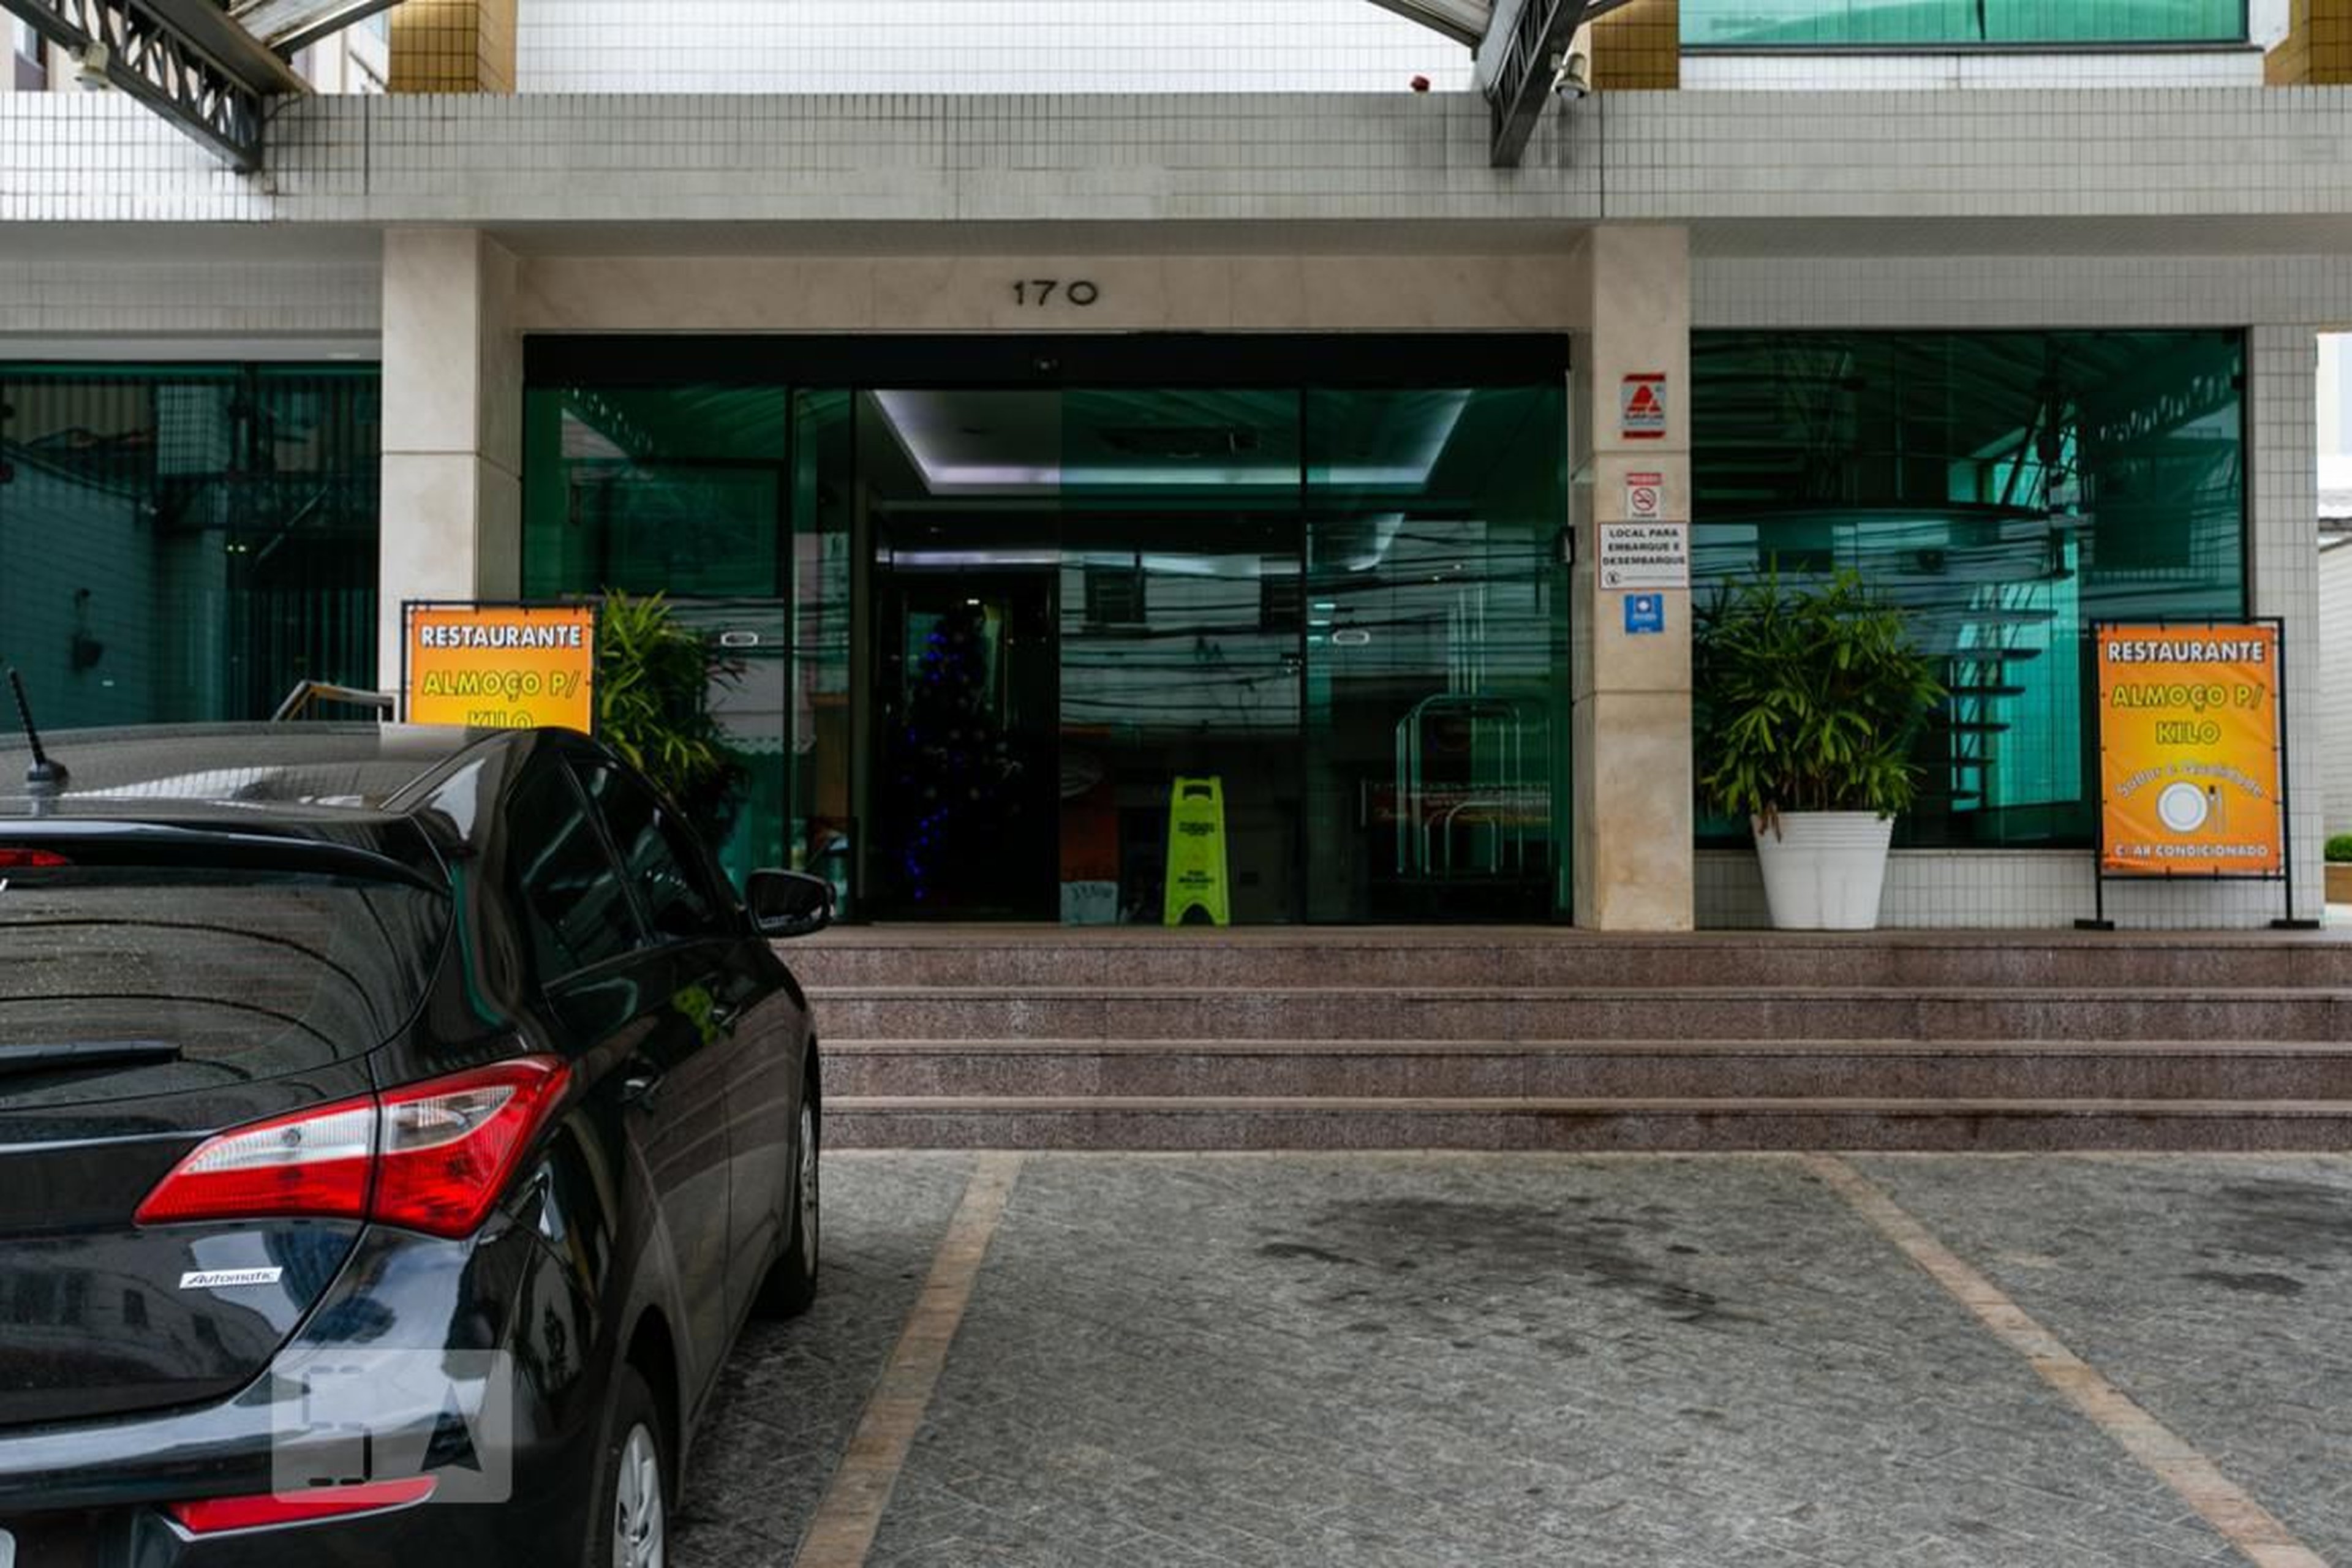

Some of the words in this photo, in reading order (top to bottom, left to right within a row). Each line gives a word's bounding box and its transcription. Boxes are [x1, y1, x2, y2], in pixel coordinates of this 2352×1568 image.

[1013, 279, 1098, 306] 170
[1609, 528, 1646, 538] LOCAL
[1649, 528, 1678, 537] PARA
[1608, 542, 1670, 551] EMBARQUE
[1602, 556, 1685, 565] DESEMBARQUE
[421, 625, 581, 647] RESTAURANTE
[2107, 641, 2265, 662] RESTAURANTE
[422, 670, 541, 701] ALMOÇO
[549, 670, 581, 698] P/
[2111, 684, 2226, 712] ALMOÇO
[2235, 684, 2264, 709] P/
[2155, 720, 2220, 745] KILO
[2155, 845, 2267, 857] CONDICIONADO
[187, 1270, 277, 1286] Automatic
